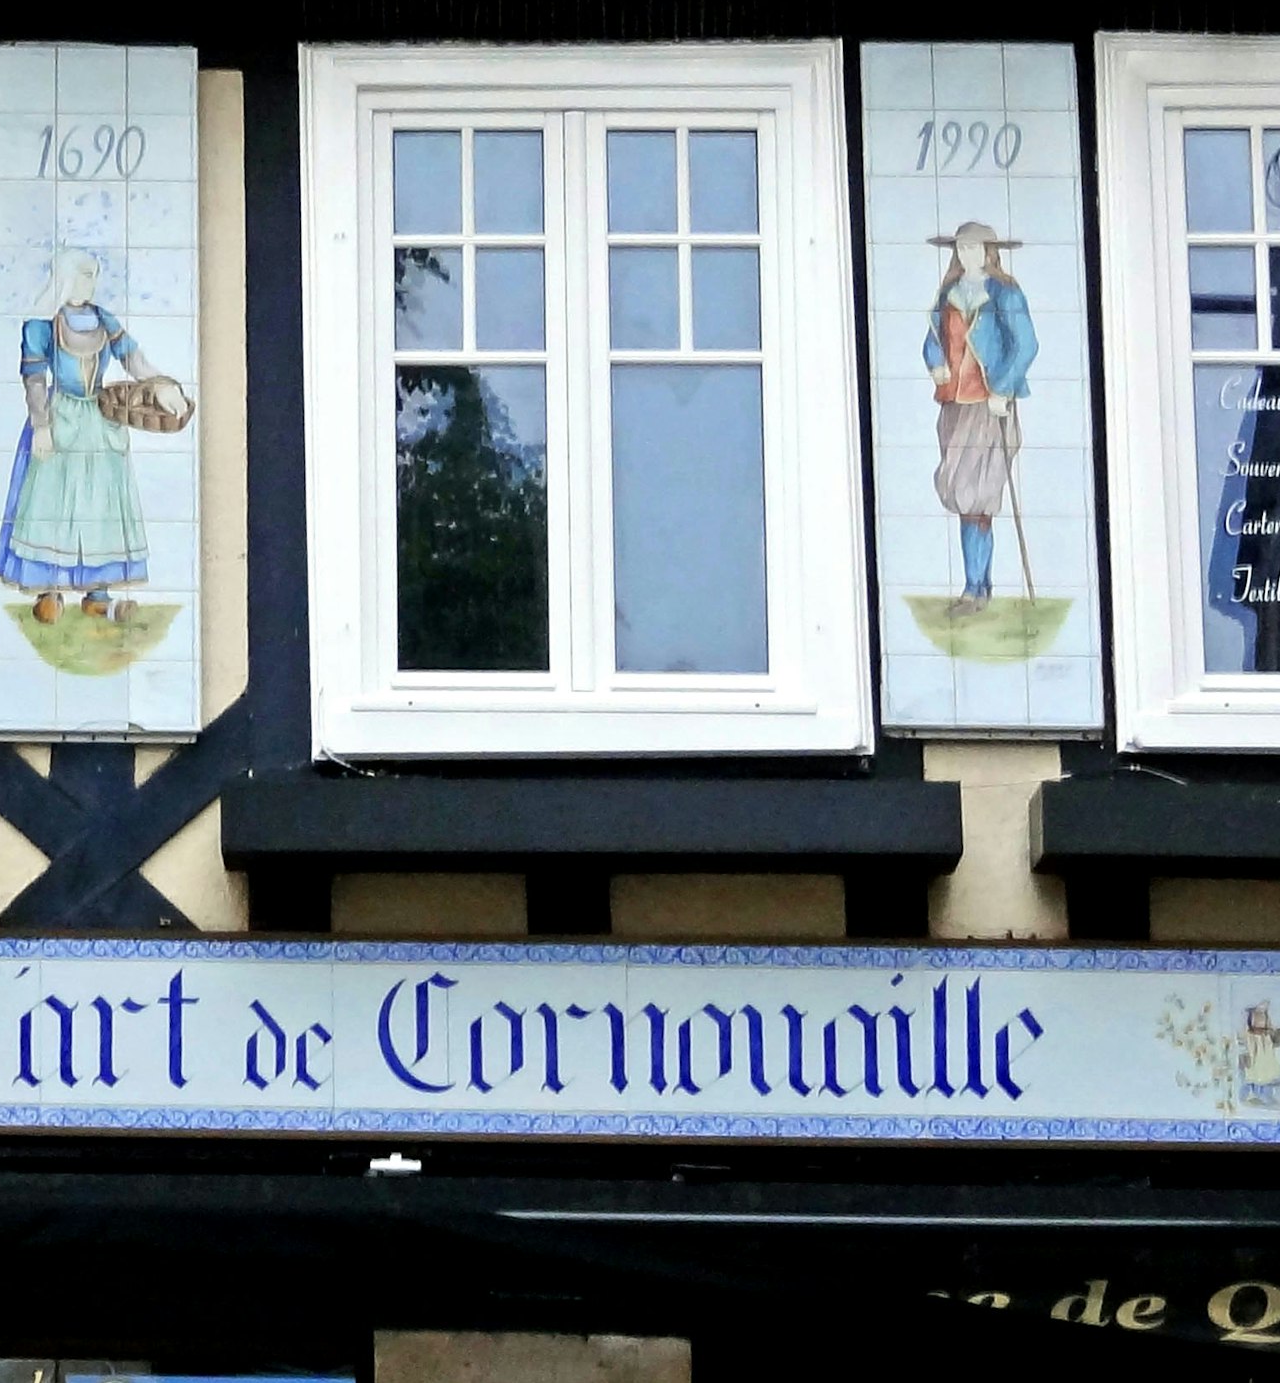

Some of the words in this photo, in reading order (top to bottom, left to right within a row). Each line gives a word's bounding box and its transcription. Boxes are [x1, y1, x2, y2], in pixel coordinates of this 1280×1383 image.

[35, 124, 146, 178] 1690
[916, 120, 1022, 171] 1990
[243, 999, 333, 1092] de
[377, 972, 1045, 1101] Cornouaille
[1050, 1279, 1167, 1330] de
